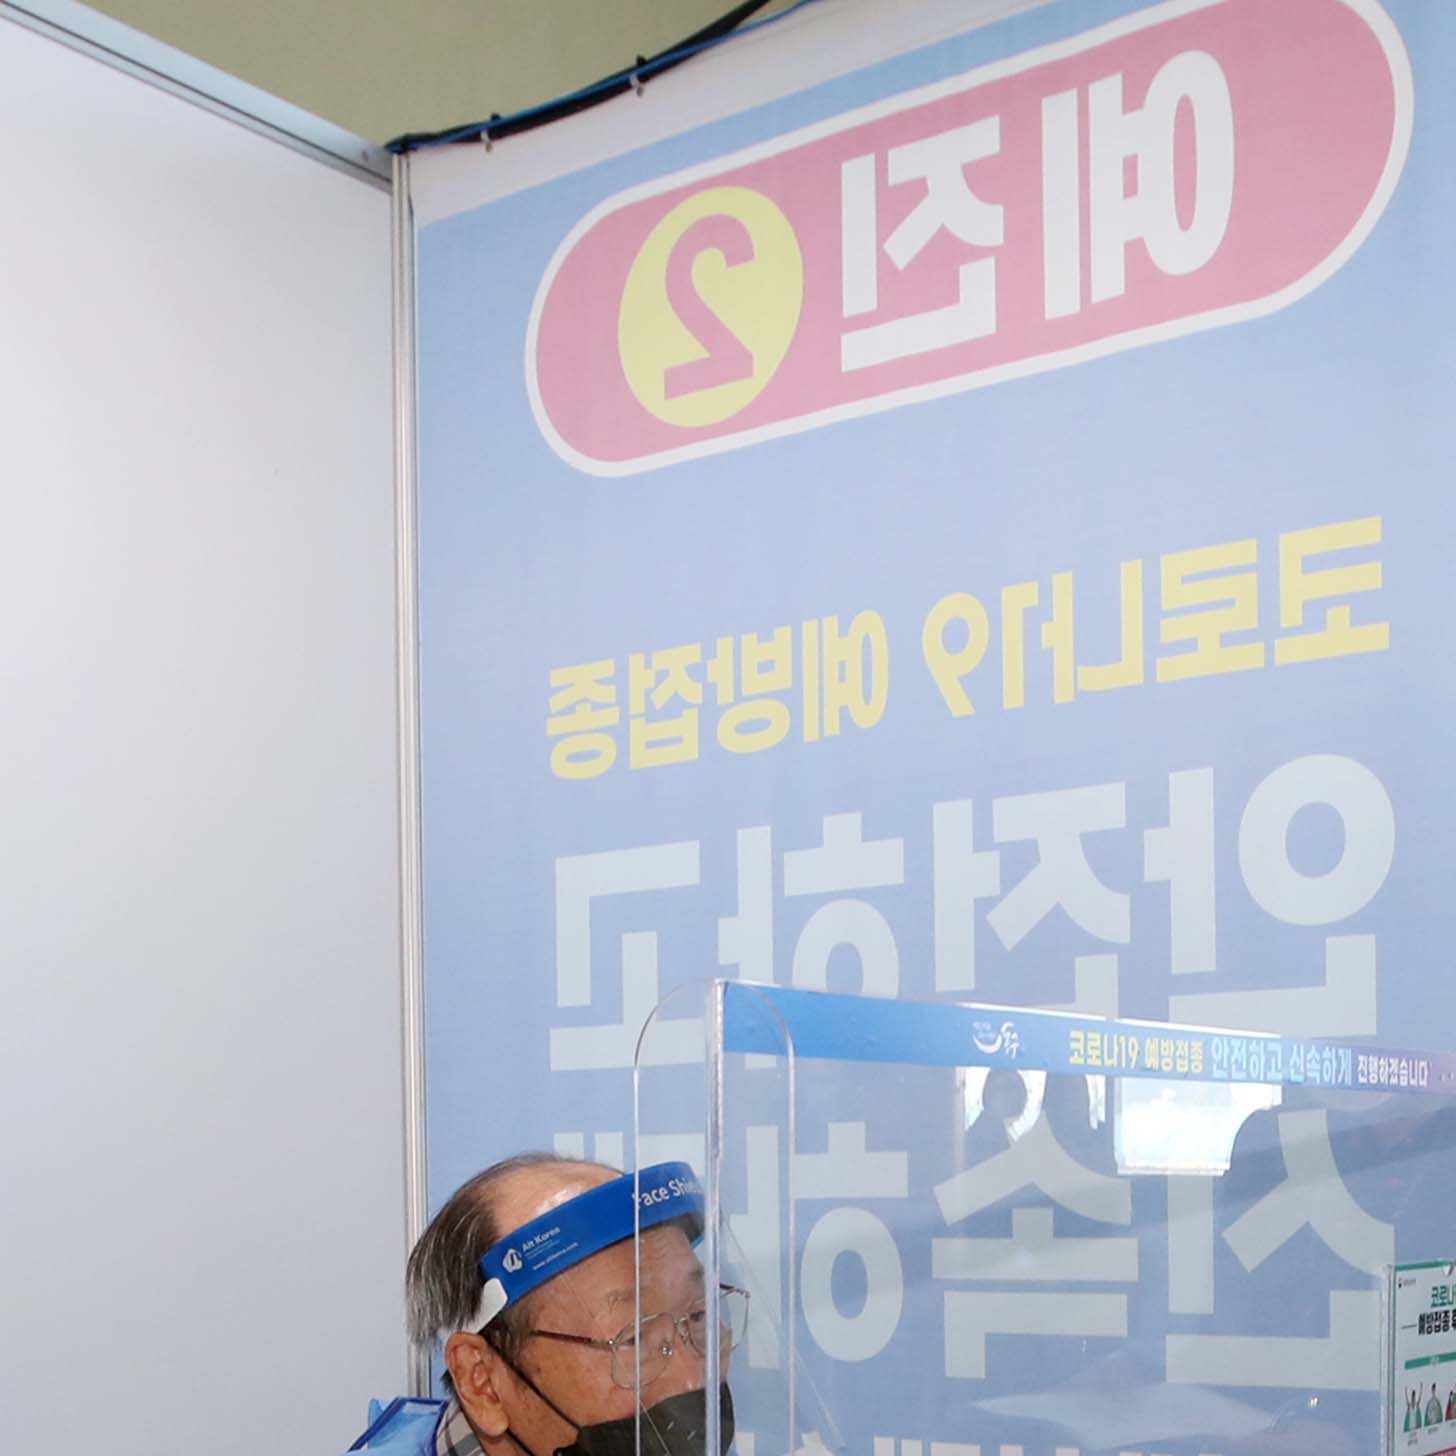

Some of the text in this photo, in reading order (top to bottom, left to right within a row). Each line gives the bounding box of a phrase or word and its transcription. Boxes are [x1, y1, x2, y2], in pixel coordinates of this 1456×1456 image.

[1069, 1029, 1430, 1088] 코로나19 예방접종 안전하고 신속하게 진행하겠습니다
